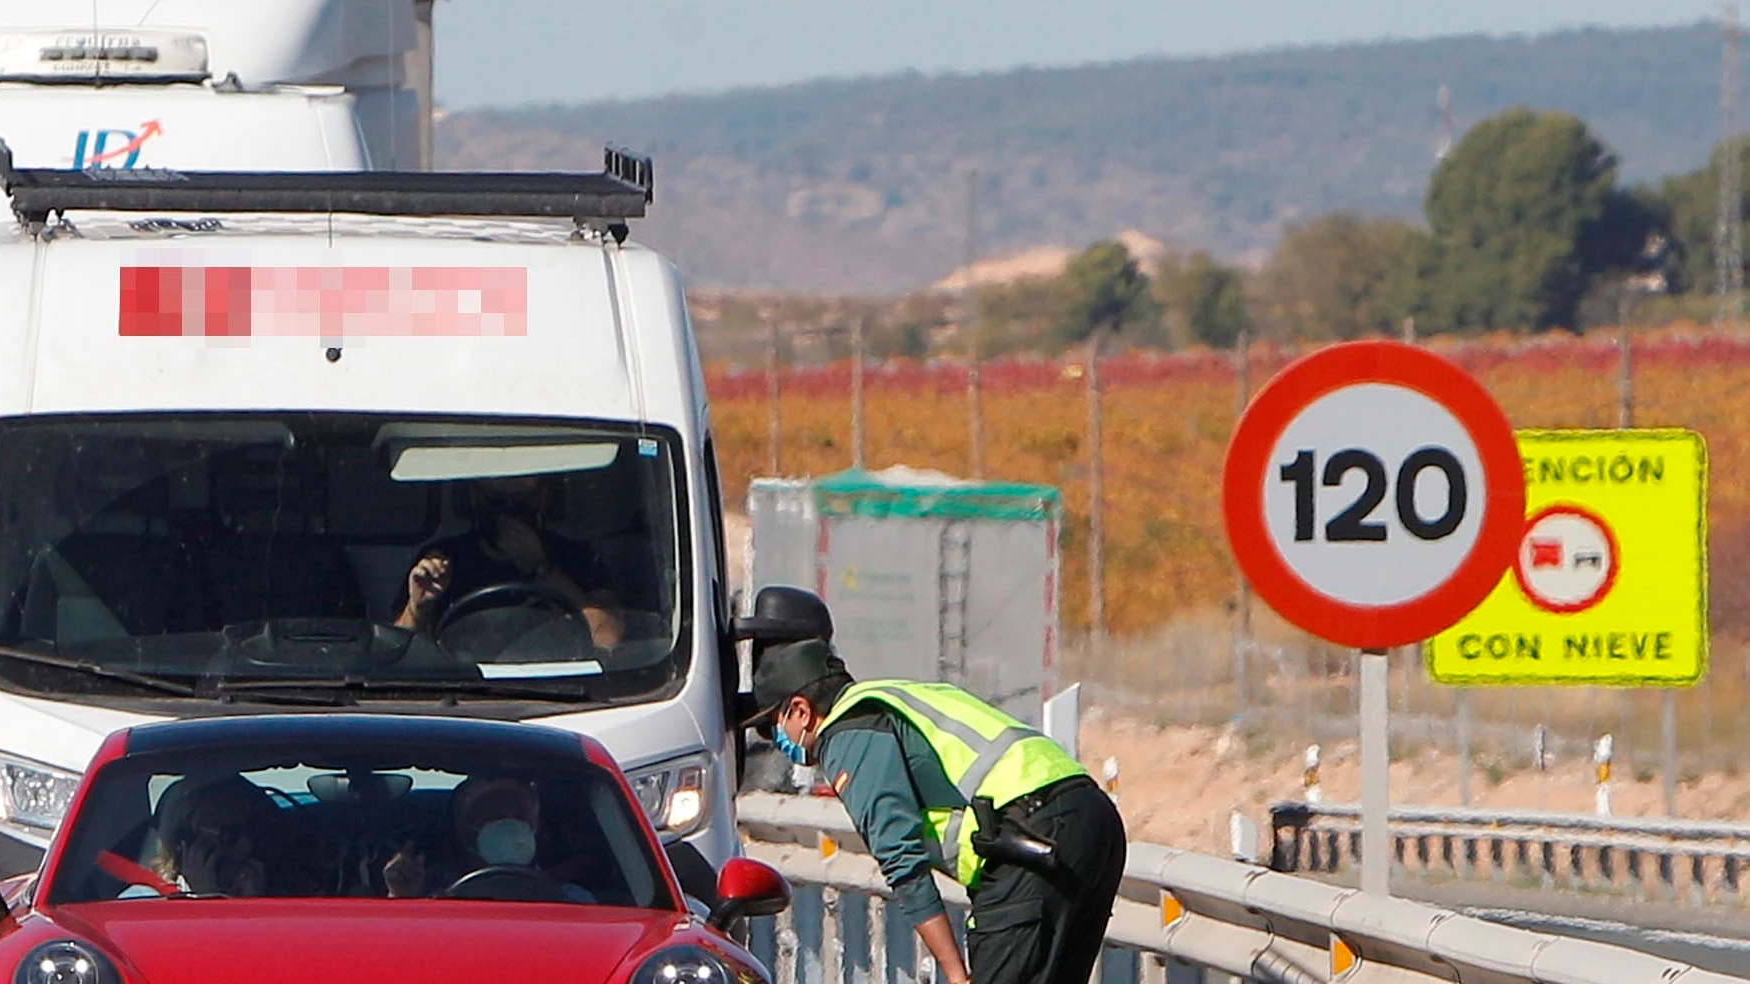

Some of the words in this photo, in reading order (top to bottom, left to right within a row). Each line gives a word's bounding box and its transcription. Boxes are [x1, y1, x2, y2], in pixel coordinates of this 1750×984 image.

[1280, 445, 1467, 540] 120
[1456, 632, 1542, 660] CON
[1563, 632, 1674, 660] NIEVE
